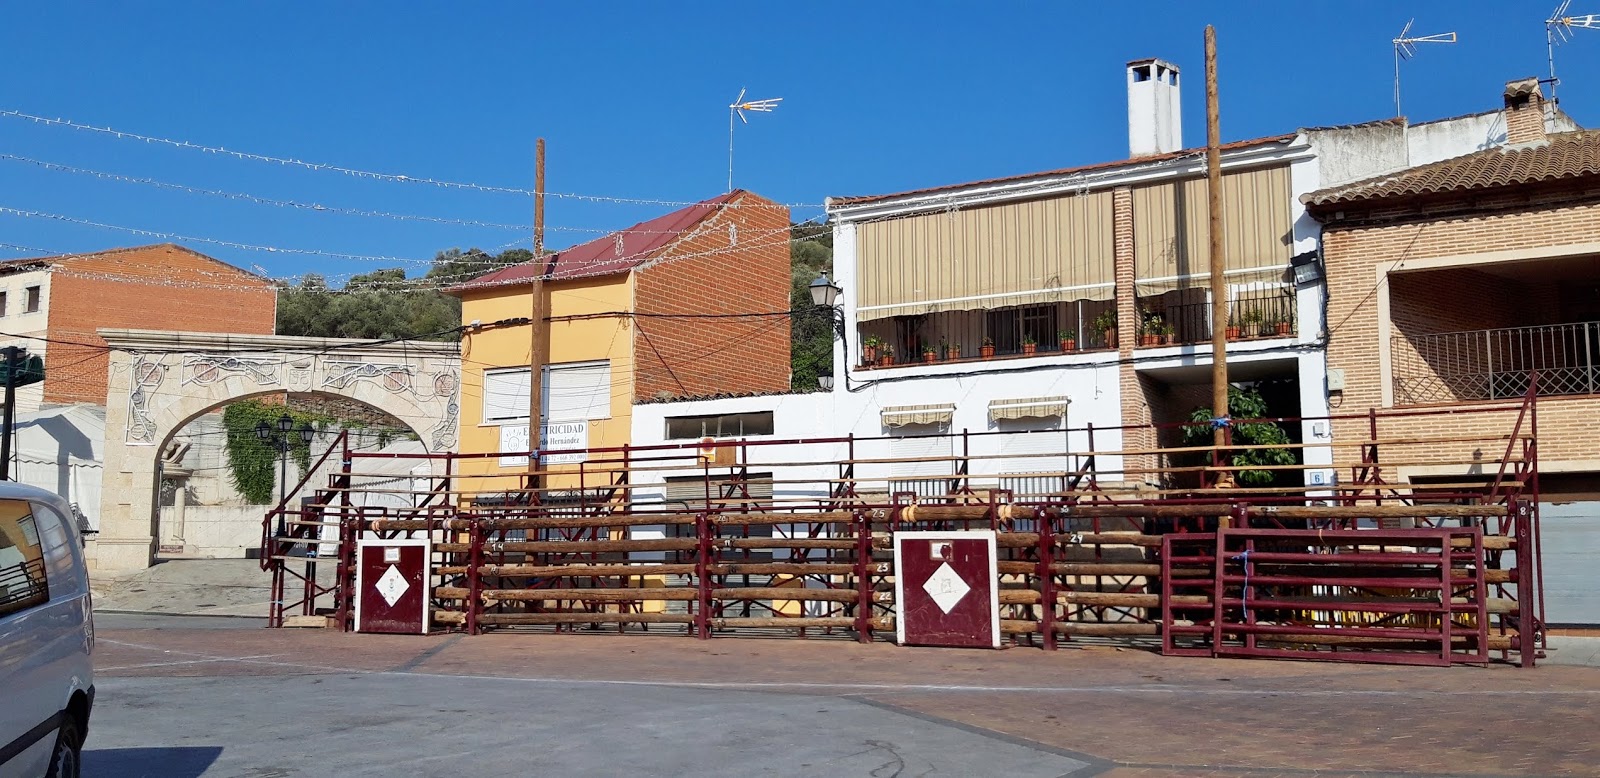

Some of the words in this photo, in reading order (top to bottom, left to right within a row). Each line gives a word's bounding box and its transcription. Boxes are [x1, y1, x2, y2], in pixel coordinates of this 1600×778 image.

[523, 423, 584, 436] ECTRICIDAD
[1314, 474, 1320, 483] 6
[872, 509, 885, 518] 25
[1520, 506, 1526, 516] 8
[1070, 534, 1083, 544] 29
[876, 563, 888, 572] 23
[879, 592, 892, 600] 22
